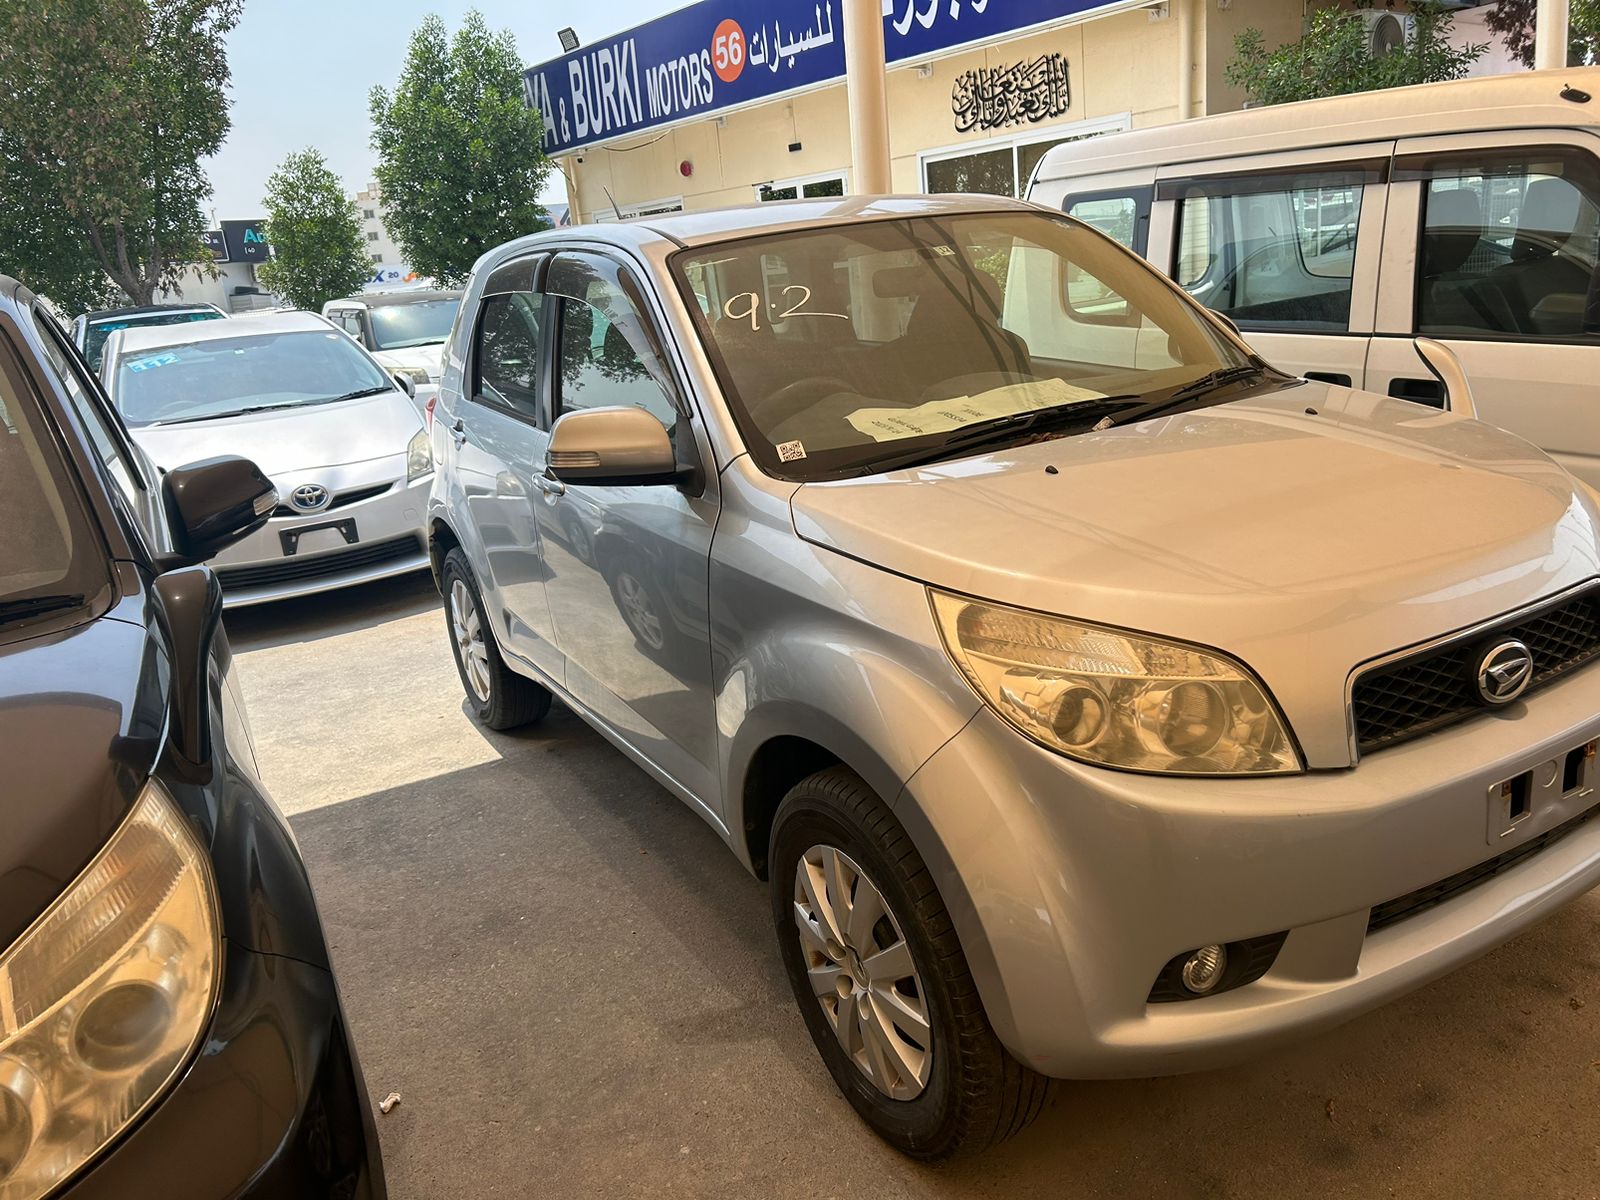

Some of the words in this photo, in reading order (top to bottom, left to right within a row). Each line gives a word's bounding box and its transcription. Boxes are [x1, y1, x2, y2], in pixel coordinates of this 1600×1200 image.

[750, 0, 834, 73] للسيارات
[522, 72, 559, 149] YA
[559, 97, 571, 143] &
[568, 38, 643, 138] BURKI
[646, 49, 713, 118] MOTORS
[716, 32, 742, 69] 56
[387, 271, 399, 279] 20
